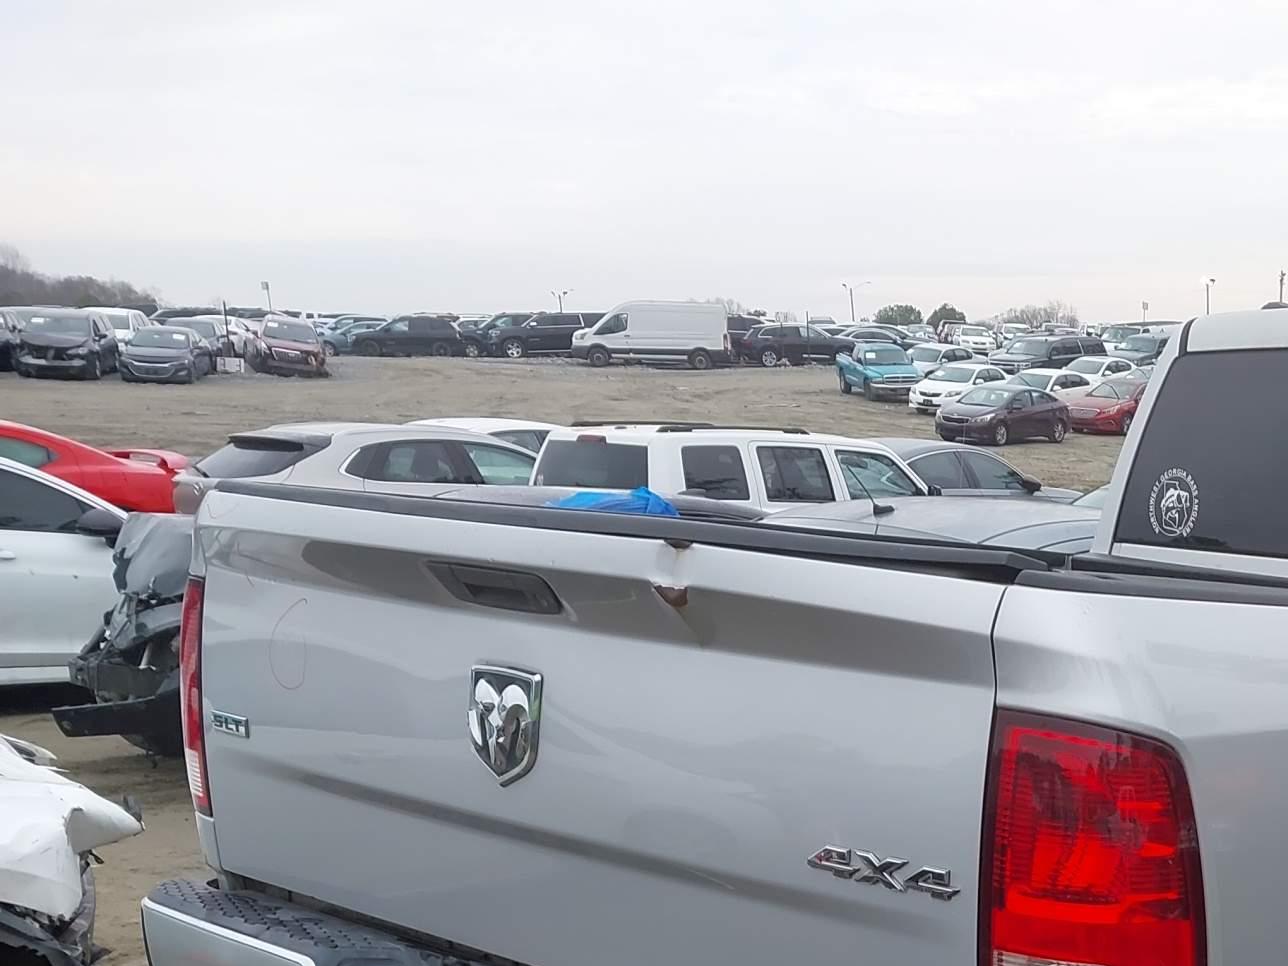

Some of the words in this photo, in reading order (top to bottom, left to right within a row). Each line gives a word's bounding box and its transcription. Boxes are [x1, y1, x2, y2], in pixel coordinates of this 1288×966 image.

[1160, 468, 1187, 482] GEORGIA
[1186, 474, 1199, 497] BASS
[212, 714, 243, 733] SLT
